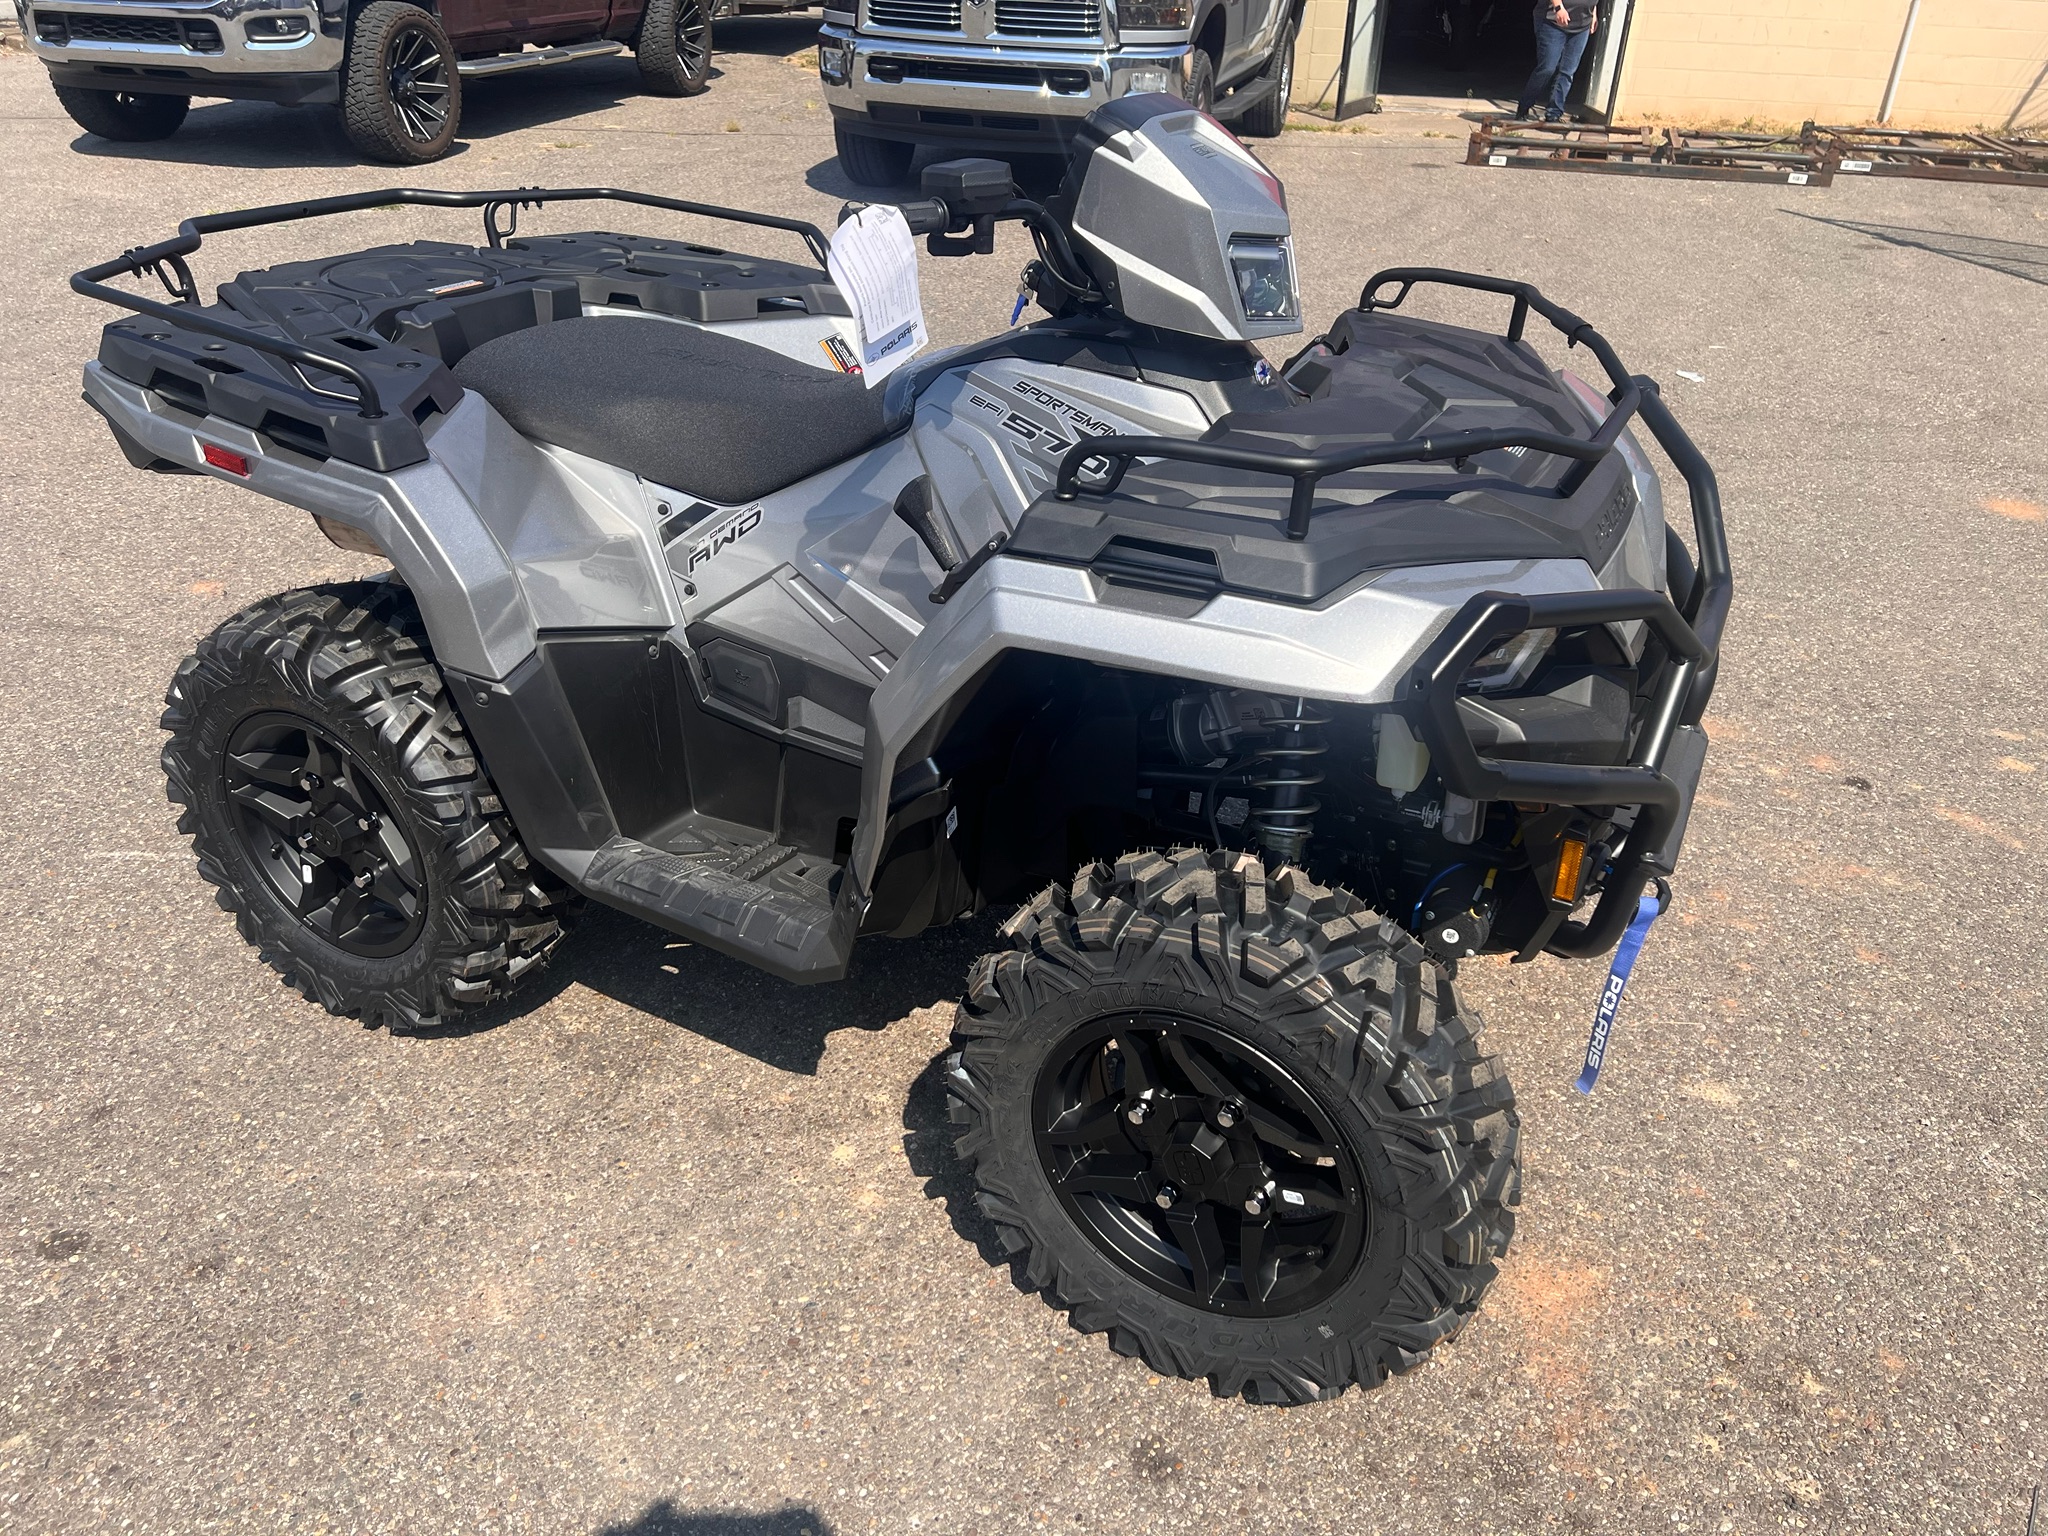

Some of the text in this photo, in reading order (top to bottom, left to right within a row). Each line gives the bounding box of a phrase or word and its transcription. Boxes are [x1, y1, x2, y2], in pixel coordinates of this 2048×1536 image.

[880, 320, 919, 356] POLARIS
[969, 395, 1005, 417] EFI
[709, 502, 760, 539] DEMAND
[689, 509, 762, 574] AWD
[1586, 974, 1624, 1070] POLARIS
